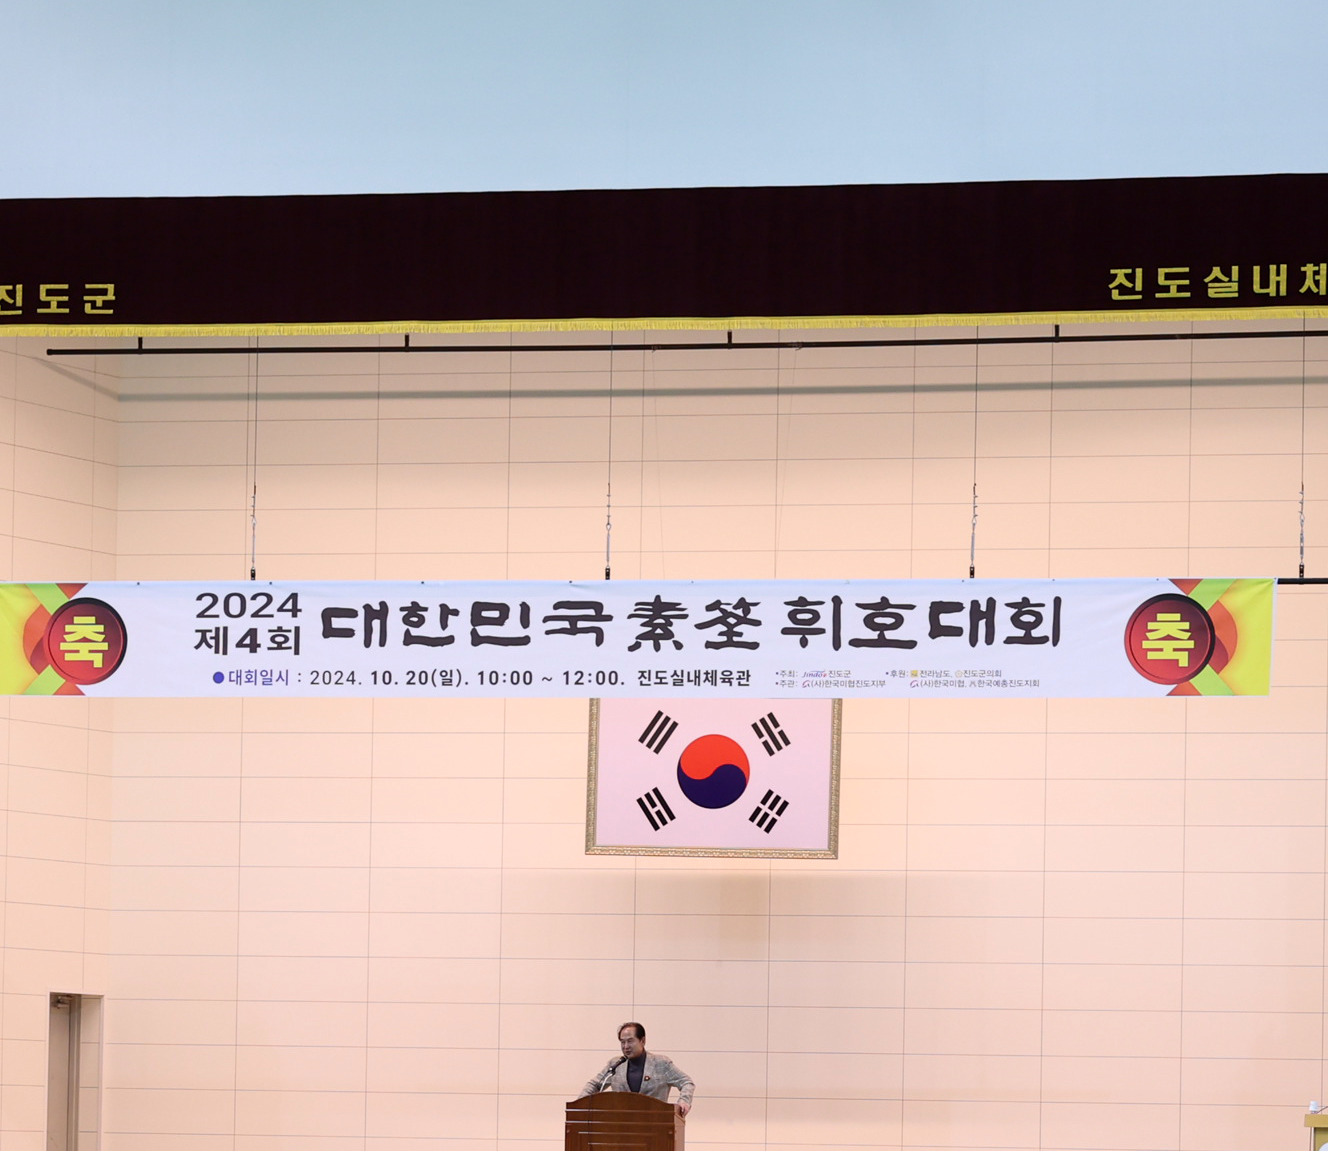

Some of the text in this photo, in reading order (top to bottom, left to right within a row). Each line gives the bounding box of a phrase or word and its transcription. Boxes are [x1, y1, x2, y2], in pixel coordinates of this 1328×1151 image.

[195, 592, 303, 619] 2024
[320, 600, 614, 649] 대한민국
[780, 594, 1063, 652] 휘호대회
[59, 615, 110, 668] 축
[193, 625, 301, 656] 제4회
[1142, 612, 1196, 667] 축
[228, 669, 289, 686] 대회일시
[310, 670, 362, 686] 2024.
[371, 670, 399, 686] 10.
[406, 669, 469, 688] 20(일).
[477, 670, 534, 686] 10:00
[562, 670, 625, 686] 12:00.
[637, 669, 752, 687] 진도실내체육관
[779, 669, 798, 678] 주최:
[828, 669, 852, 678] 진도군
[779, 679, 798, 688] 주관:
[889, 669, 1002, 678] 후원: 전라남도, 진도군의회
